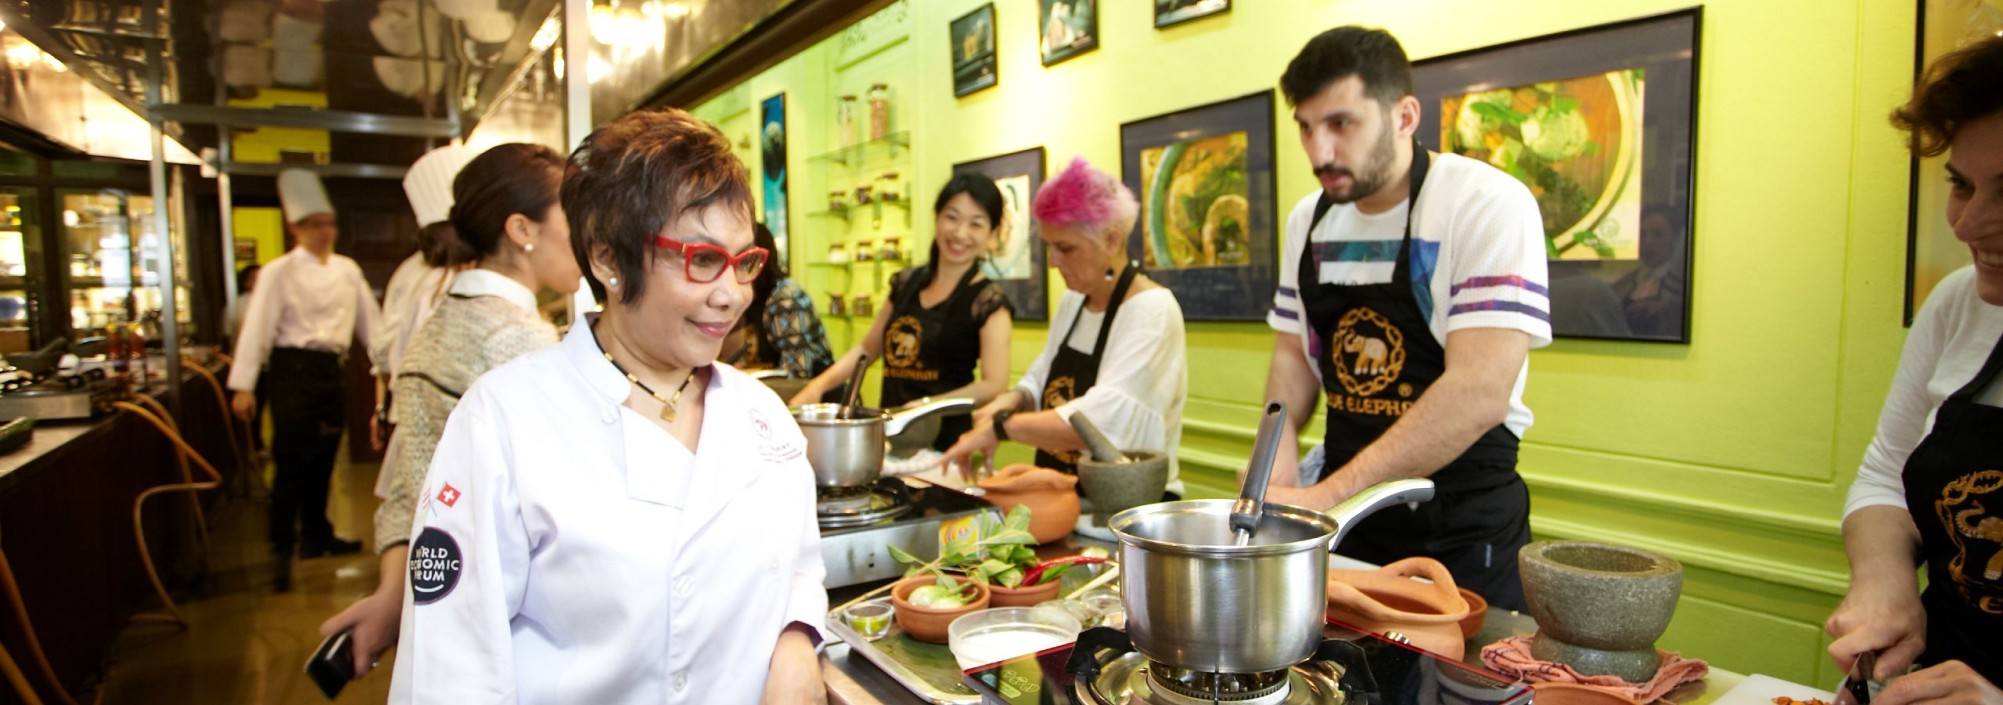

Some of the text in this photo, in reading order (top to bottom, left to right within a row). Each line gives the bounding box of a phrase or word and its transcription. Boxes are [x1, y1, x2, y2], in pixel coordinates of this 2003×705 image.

[1346, 396, 1415, 416] ELEPHA
[416, 546, 449, 559] RLD
[414, 570, 445, 582] RUM
